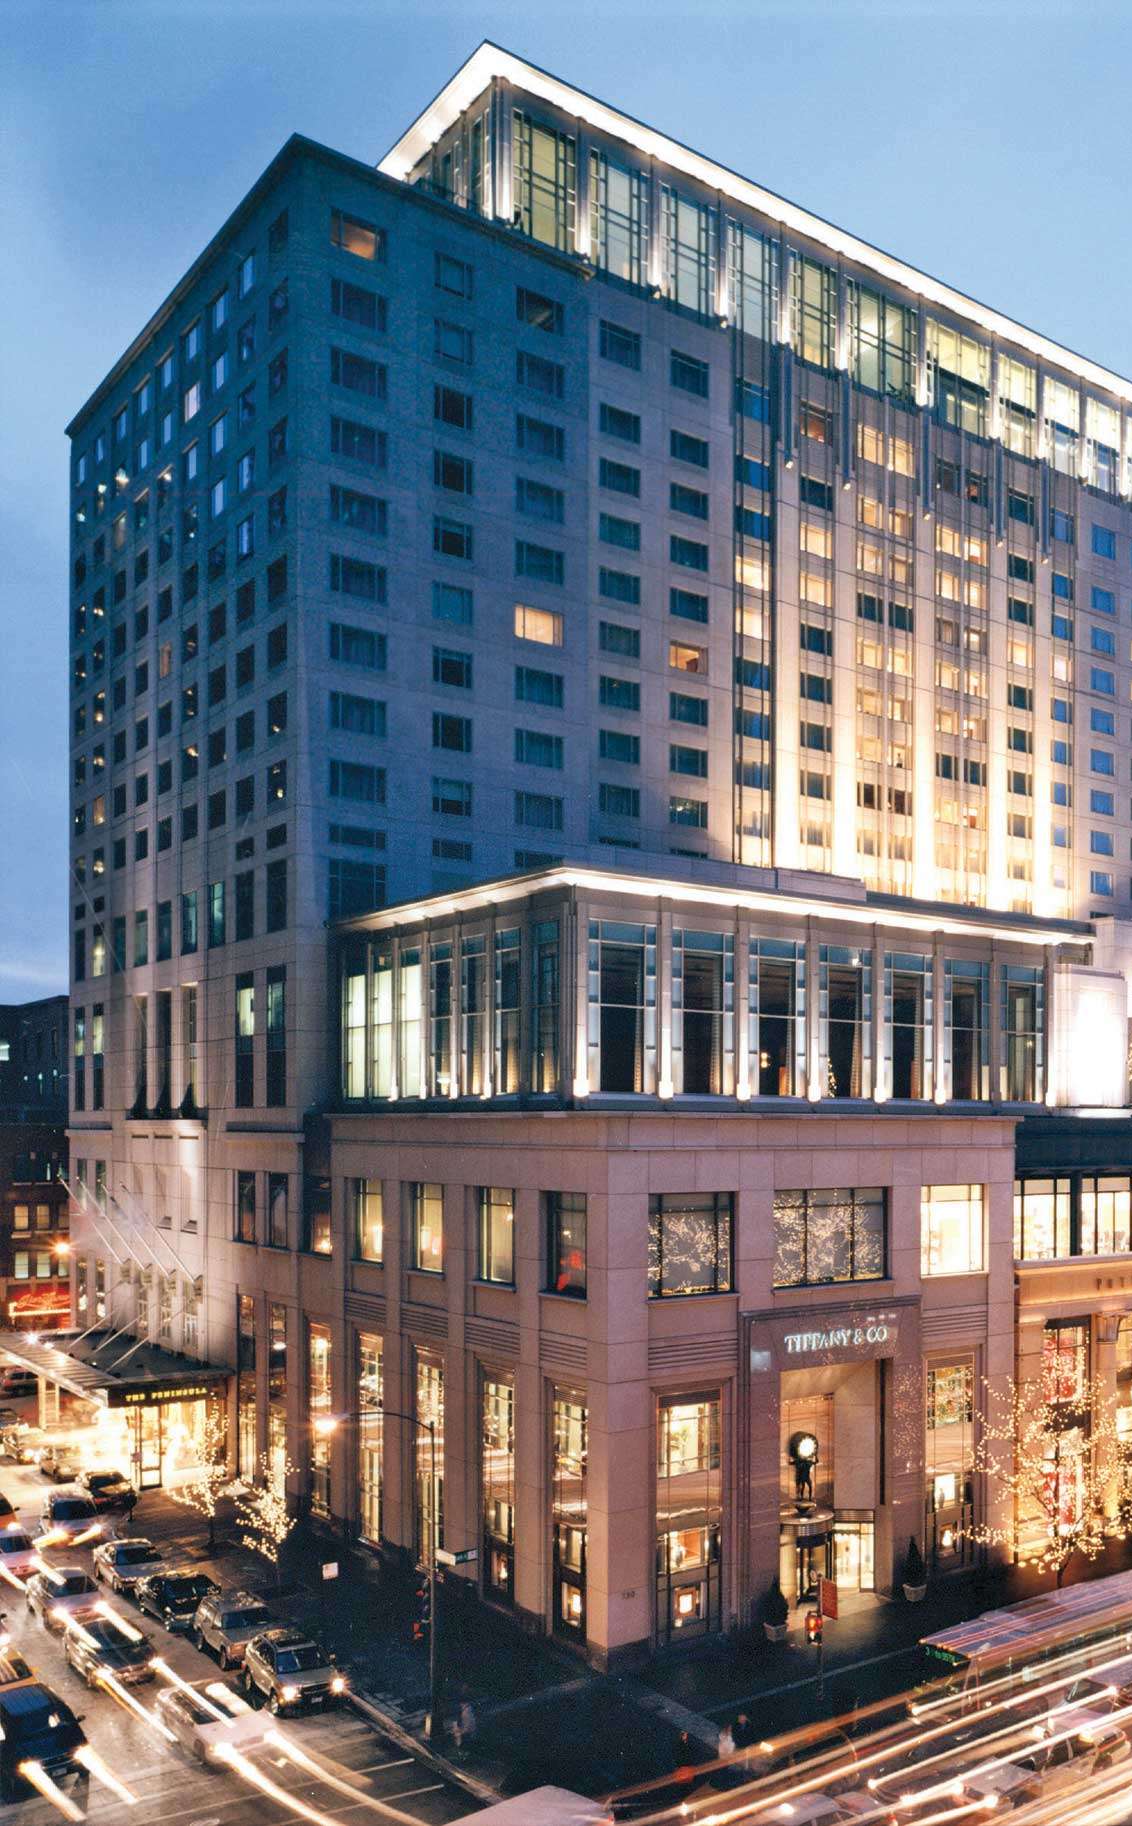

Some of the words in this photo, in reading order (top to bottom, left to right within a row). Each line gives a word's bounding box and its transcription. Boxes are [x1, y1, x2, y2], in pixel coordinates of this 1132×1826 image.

[784, 1328, 851, 1353] TIFFANY
[125, 1393, 145, 1401] THE
[151, 1387, 207, 1399] PENINSULA
